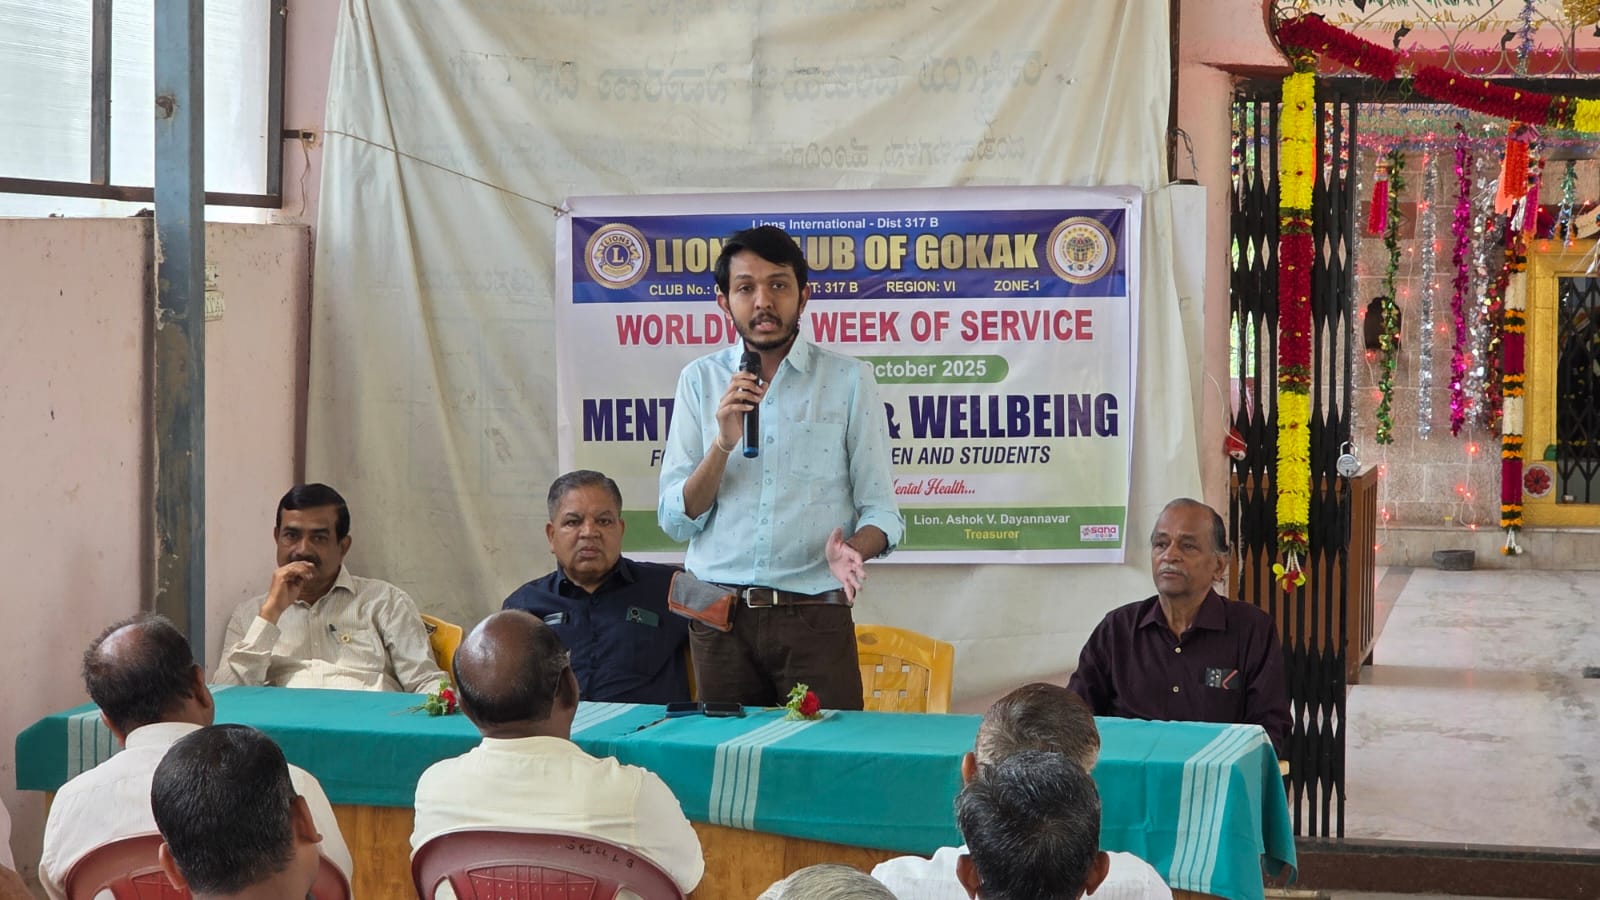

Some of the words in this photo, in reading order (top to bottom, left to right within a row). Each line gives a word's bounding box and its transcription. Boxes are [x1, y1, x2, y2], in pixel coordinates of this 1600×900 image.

[752, 219, 786, 230] Lions
[789, 218, 866, 229] International
[877, 218, 901, 228] Dist
[905, 217, 926, 228] 317
[930, 217, 939, 227] B
[604, 235, 630, 245] LIONS
[611, 247, 624, 263] L
[655, 238, 728, 273] LION
[864, 235, 906, 270] OF
[915, 233, 1039, 270] GOKAK
[649, 284, 683, 296] CLUB
[687, 284, 710, 295] No.:
[825, 282, 845, 293] 317
[849, 281, 858, 292] B
[886, 281, 940, 293] REGION:
[944, 281, 956, 292] VI
[994, 280, 1040, 292] ZONE-1
[811, 311, 900, 343] WEEK
[911, 310, 949, 342] OF
[961, 309, 1093, 342] SERVICE
[866, 360, 936, 377] ctober
[942, 360, 987, 377] 2025
[582, 398, 675, 442] MENT
[908, 393, 1118, 439] WELLBEING
[917, 446, 954, 465] AND
[960, 445, 1051, 464] STUDENTS
[893, 479, 923, 495] ental
[924, 478, 975, 496] Health...
[914, 514, 943, 526] Lion.
[946, 514, 983, 525] Ashok
[987, 514, 997, 525] V.
[1001, 513, 1070, 529] Dayannavar
[964, 528, 1020, 540] Treasurer
